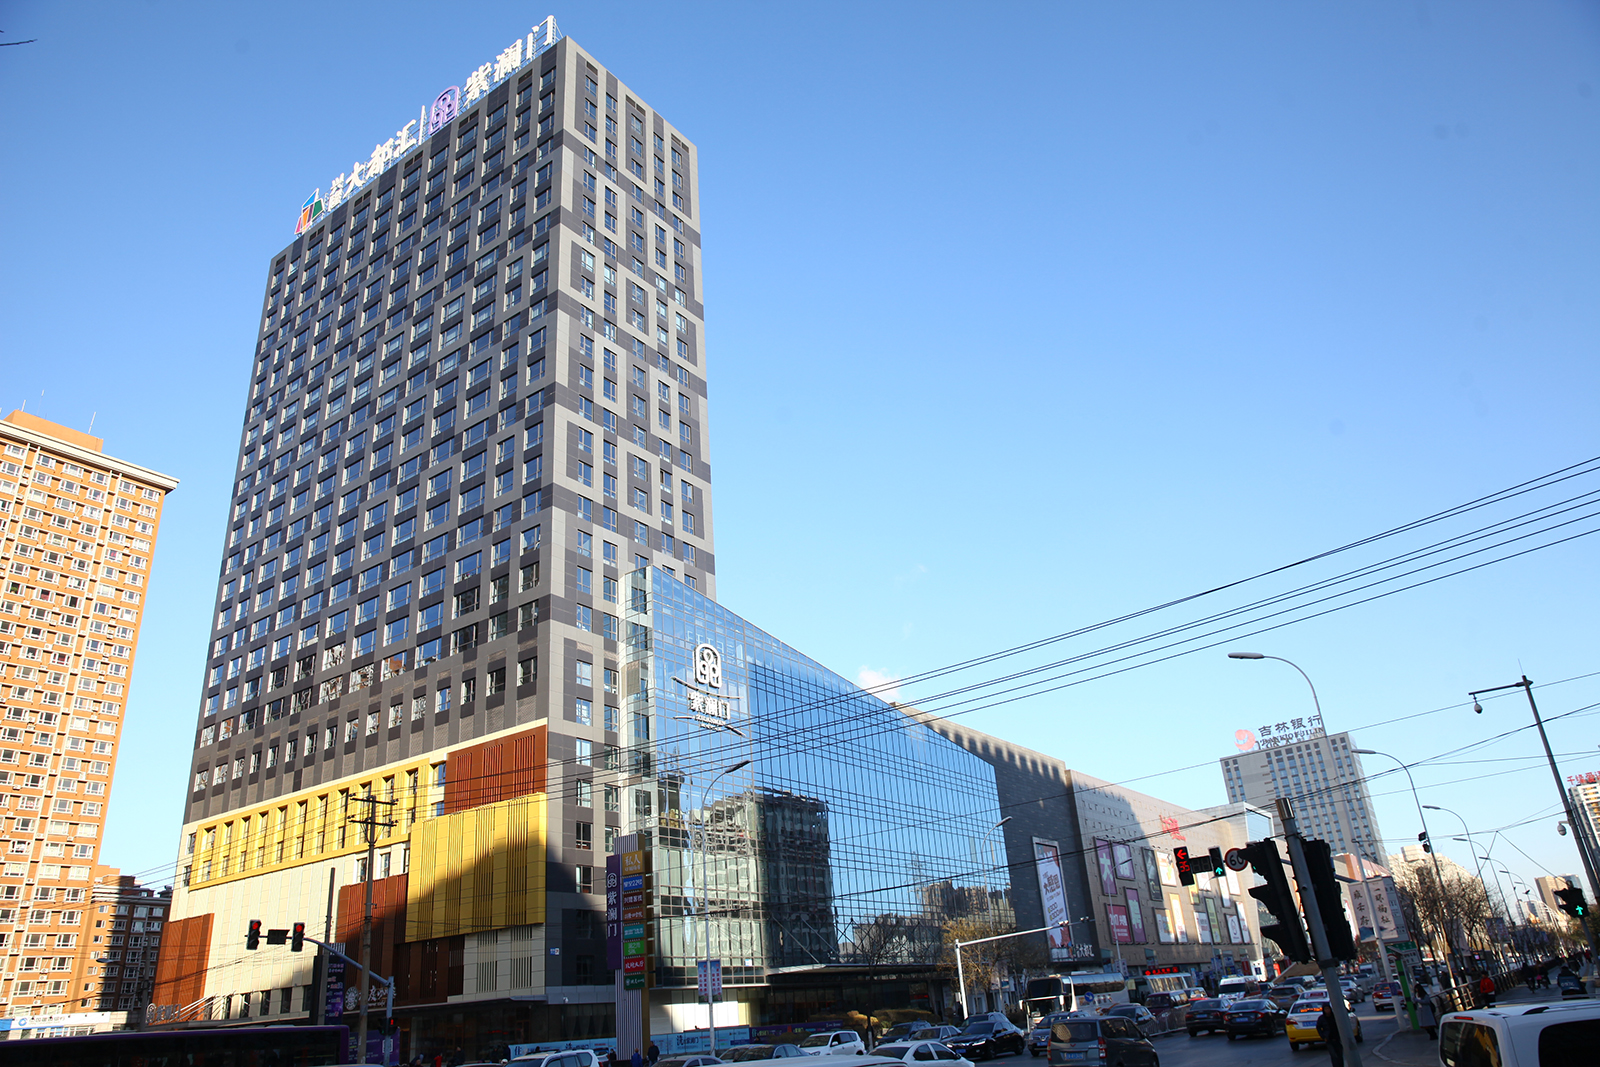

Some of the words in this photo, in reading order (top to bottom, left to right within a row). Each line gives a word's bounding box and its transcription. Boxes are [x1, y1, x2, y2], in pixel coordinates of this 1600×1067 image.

[463, 15, 555, 107] 紫澜门
[1258, 714, 1321, 737] 吉林银行
[607, 890, 618, 937] 紫澜门
